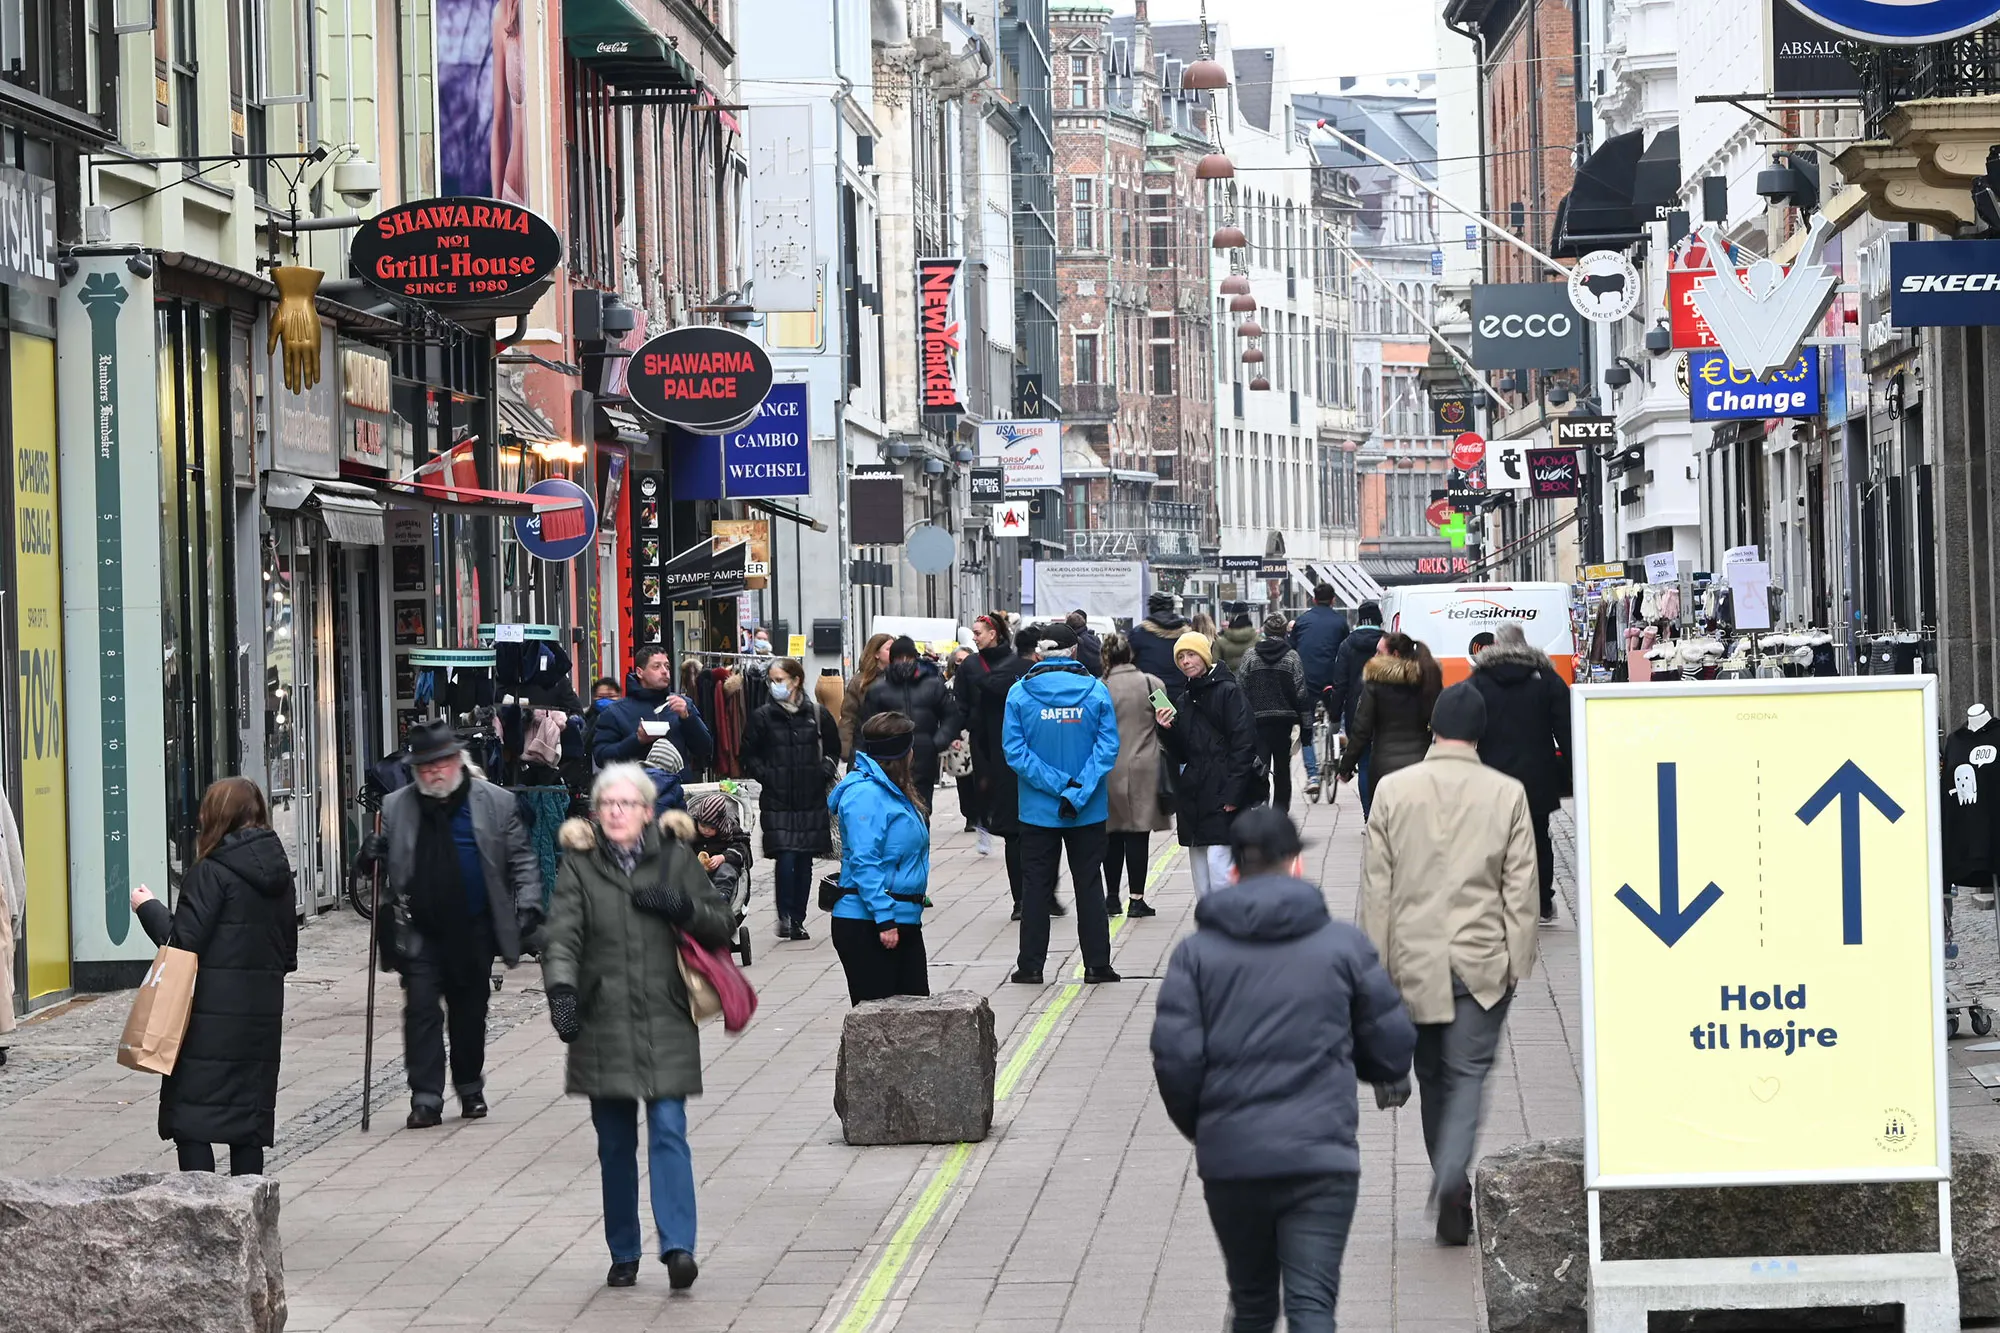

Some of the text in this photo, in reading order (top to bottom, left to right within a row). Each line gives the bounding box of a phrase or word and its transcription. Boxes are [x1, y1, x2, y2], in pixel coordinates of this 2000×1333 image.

[377, 205, 530, 239] SHAWARMA
[376, 252, 536, 279] Grill-House
[1584, 253, 1619, 266] VILLAGE
[404, 279, 508, 295] SINCE 1980
[1572, 270, 1590, 314] HEREFORD
[1591, 310, 1614, 319] BEEF
[1621, 265, 1637, 310] SPARERIBS
[1479, 313, 1571, 339] ecco
[644, 351, 755, 376] SHAWARMA
[664, 377, 737, 400] PALACE
[1706, 390, 1807, 414] Change
[1559, 423, 1613, 438] NEYE
[734, 432, 799, 448] CAMBIO
[1533, 454, 1575, 466] MOMO
[18, 447, 50, 495] OPHØRS
[729, 463, 806, 478] WECHSEL
[1540, 482, 1570, 491] BOX
[19, 507, 51, 556] UDSALG
[1073, 532, 1138, 555] PIZZA
[1417, 558, 1448, 574] JORCKS
[1448, 607, 1537, 621] telesikring
[20, 648, 60, 761] 70%
[1040, 707, 1084, 720] SAFETY
[1736, 711, 1779, 721] CORONA
[108, 738, 118, 750] 10
[1974, 747, 1993, 762] BOO
[110, 783, 119, 796] 11
[111, 829, 121, 842] 12
[1720, 983, 1807, 1012] Hold
[1690, 1020, 1838, 1056] til højre
